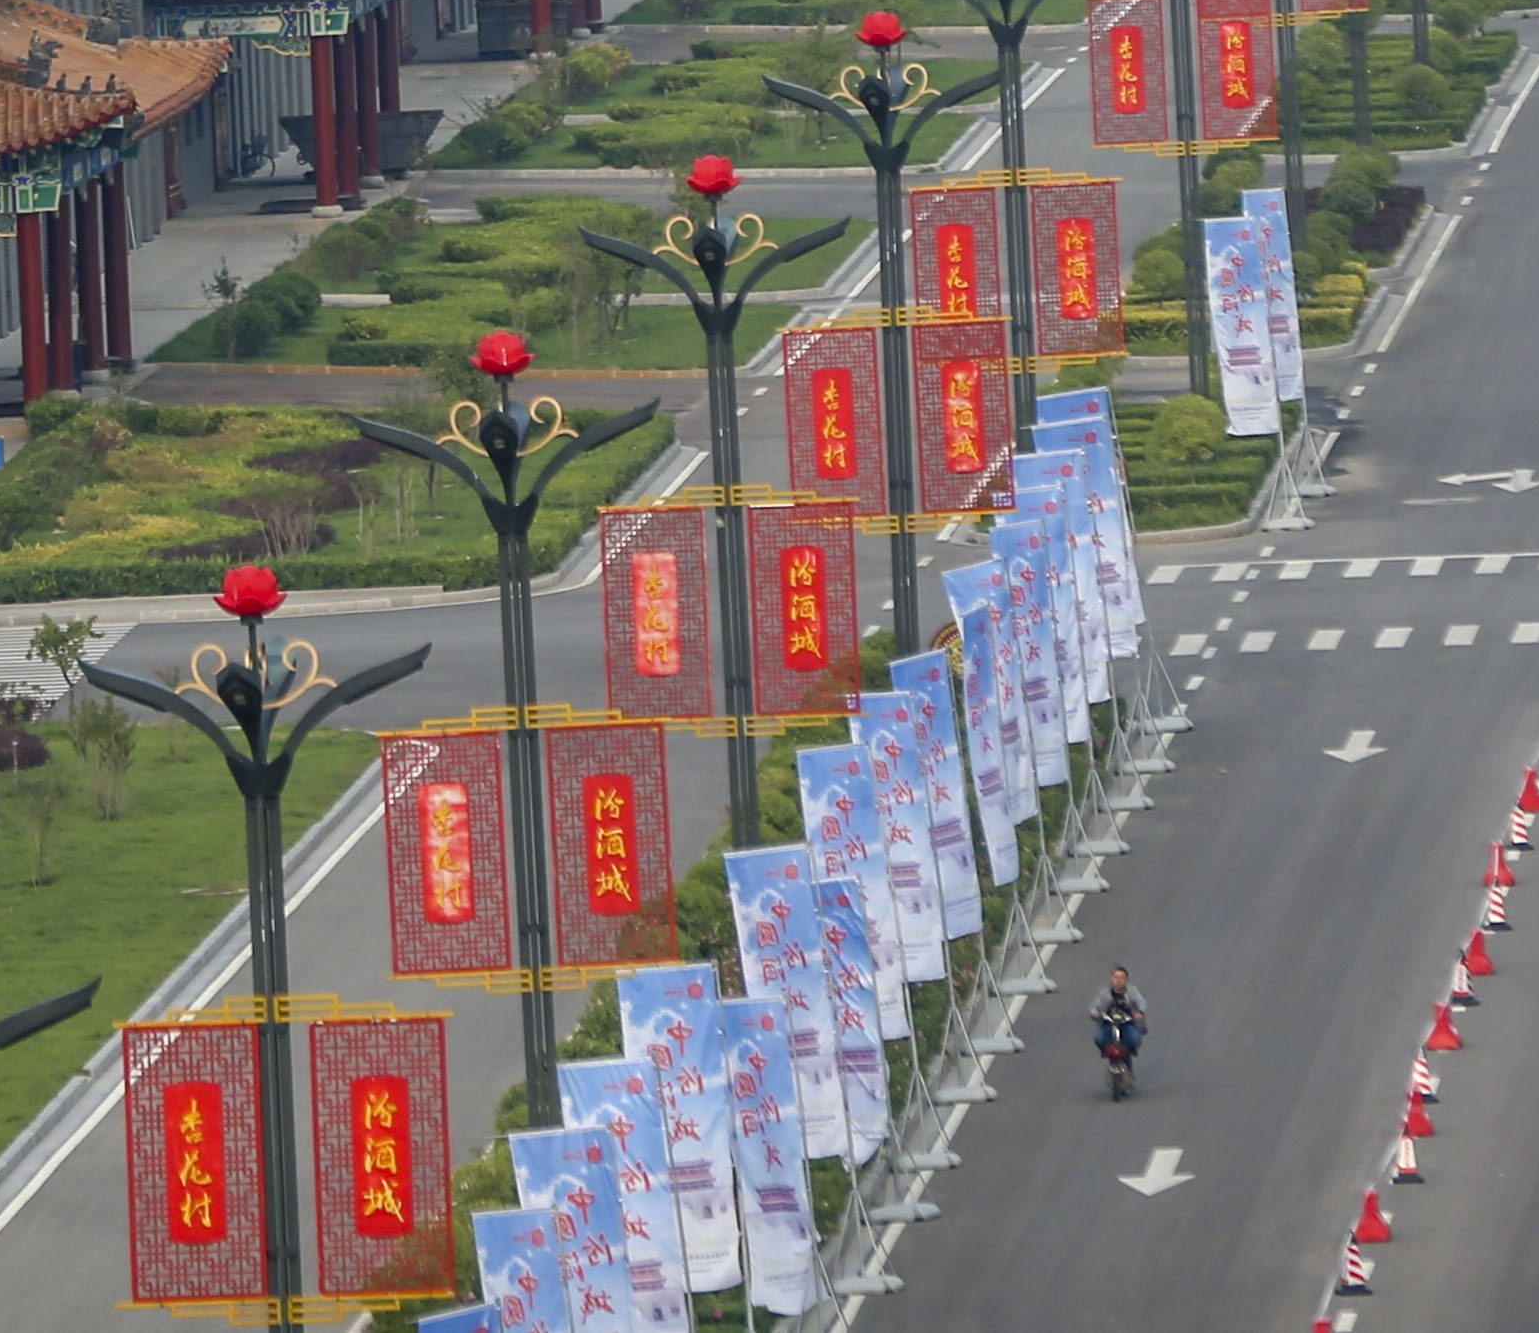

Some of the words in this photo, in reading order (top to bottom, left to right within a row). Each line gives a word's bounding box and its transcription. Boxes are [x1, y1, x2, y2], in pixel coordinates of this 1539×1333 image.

[1118, 35, 1139, 105] 杏花村
[1226, 21, 1250, 99] 汾酒城
[946, 236, 969, 313] 杏花村
[1066, 228, 1093, 311] 汾酒城
[822, 379, 848, 470] 杏花村
[951, 374, 979, 462] 汾酒城
[643, 573, 670, 663] 杏花村
[790, 557, 823, 659] 汾酒城
[430, 798, 464, 913] 杏花村
[594, 787, 633, 903] 汾酒城
[178, 1098, 213, 1229] 杏花村
[363, 1090, 405, 1223] 汾酒城
